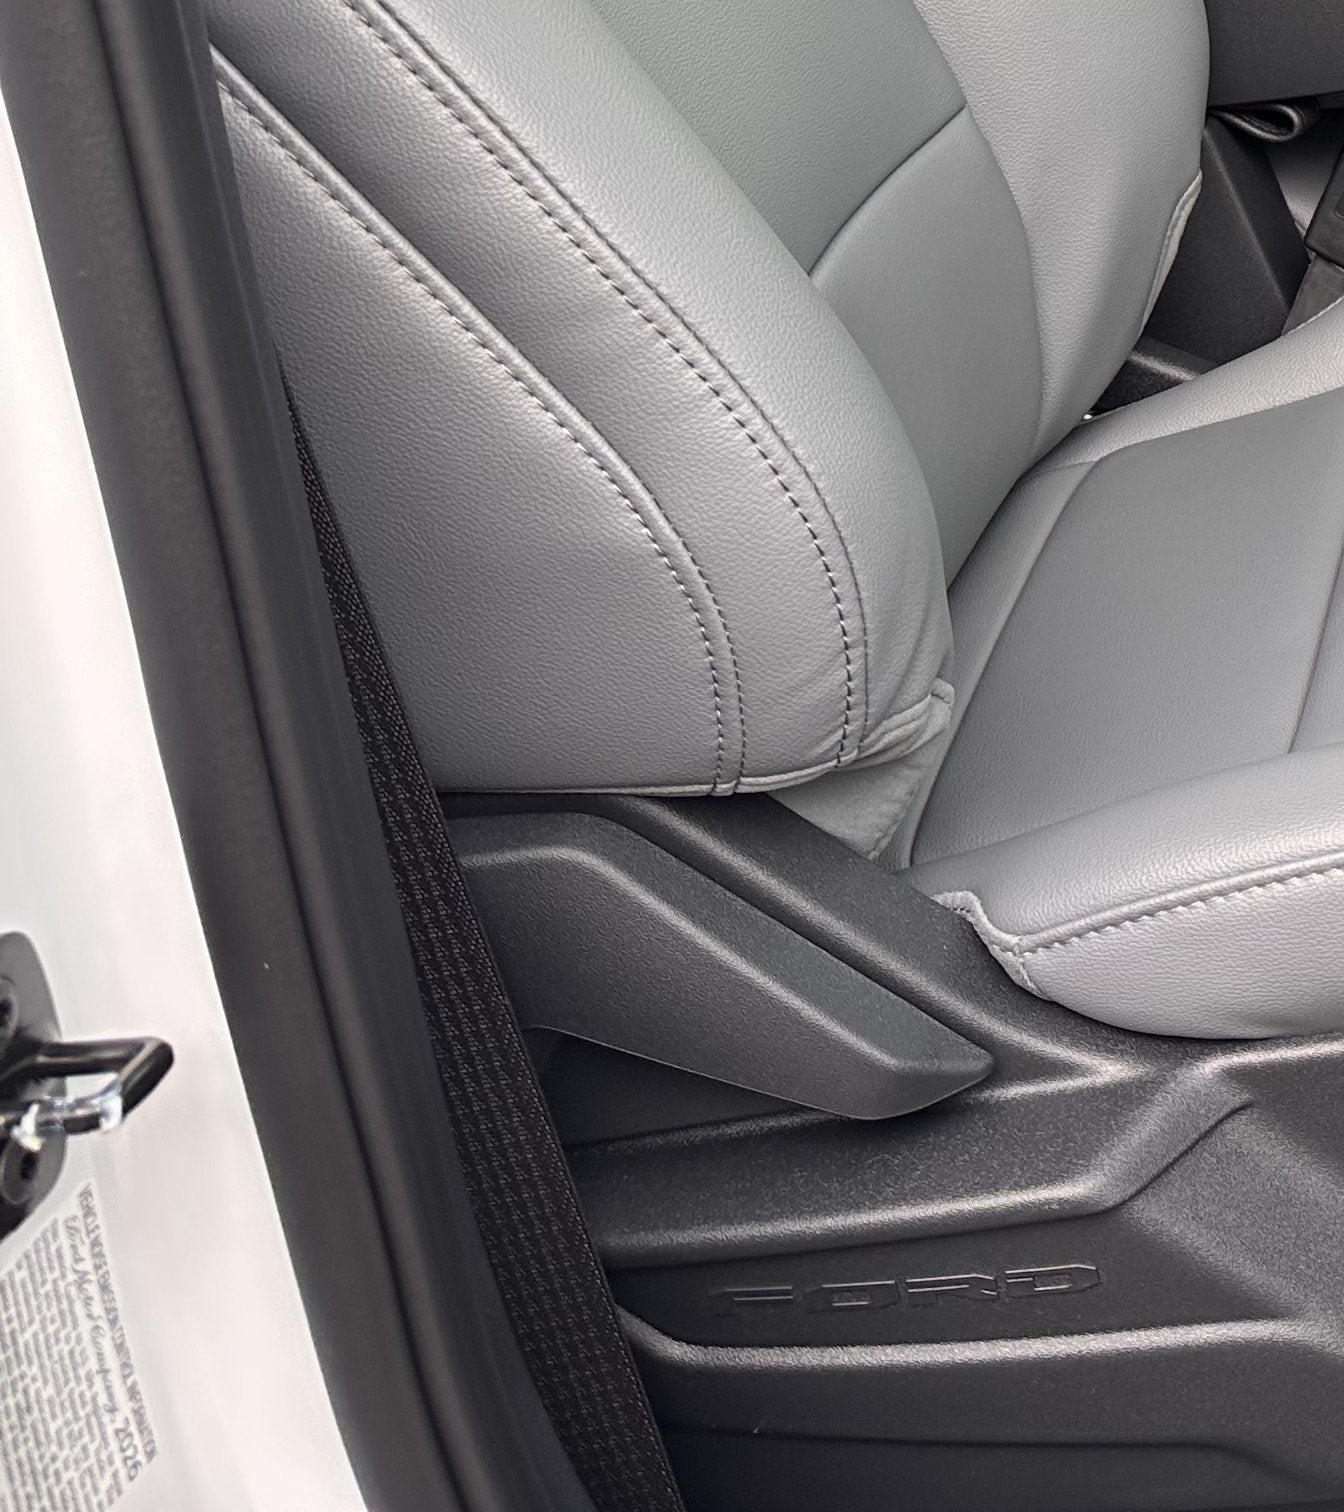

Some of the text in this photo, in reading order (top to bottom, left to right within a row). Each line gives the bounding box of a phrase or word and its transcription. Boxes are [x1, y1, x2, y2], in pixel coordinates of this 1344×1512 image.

[79, 1183, 101, 1240] VEHICLE
[711, 1263, 1100, 1316] FORD
[114, 1417, 142, 1482] 2026
